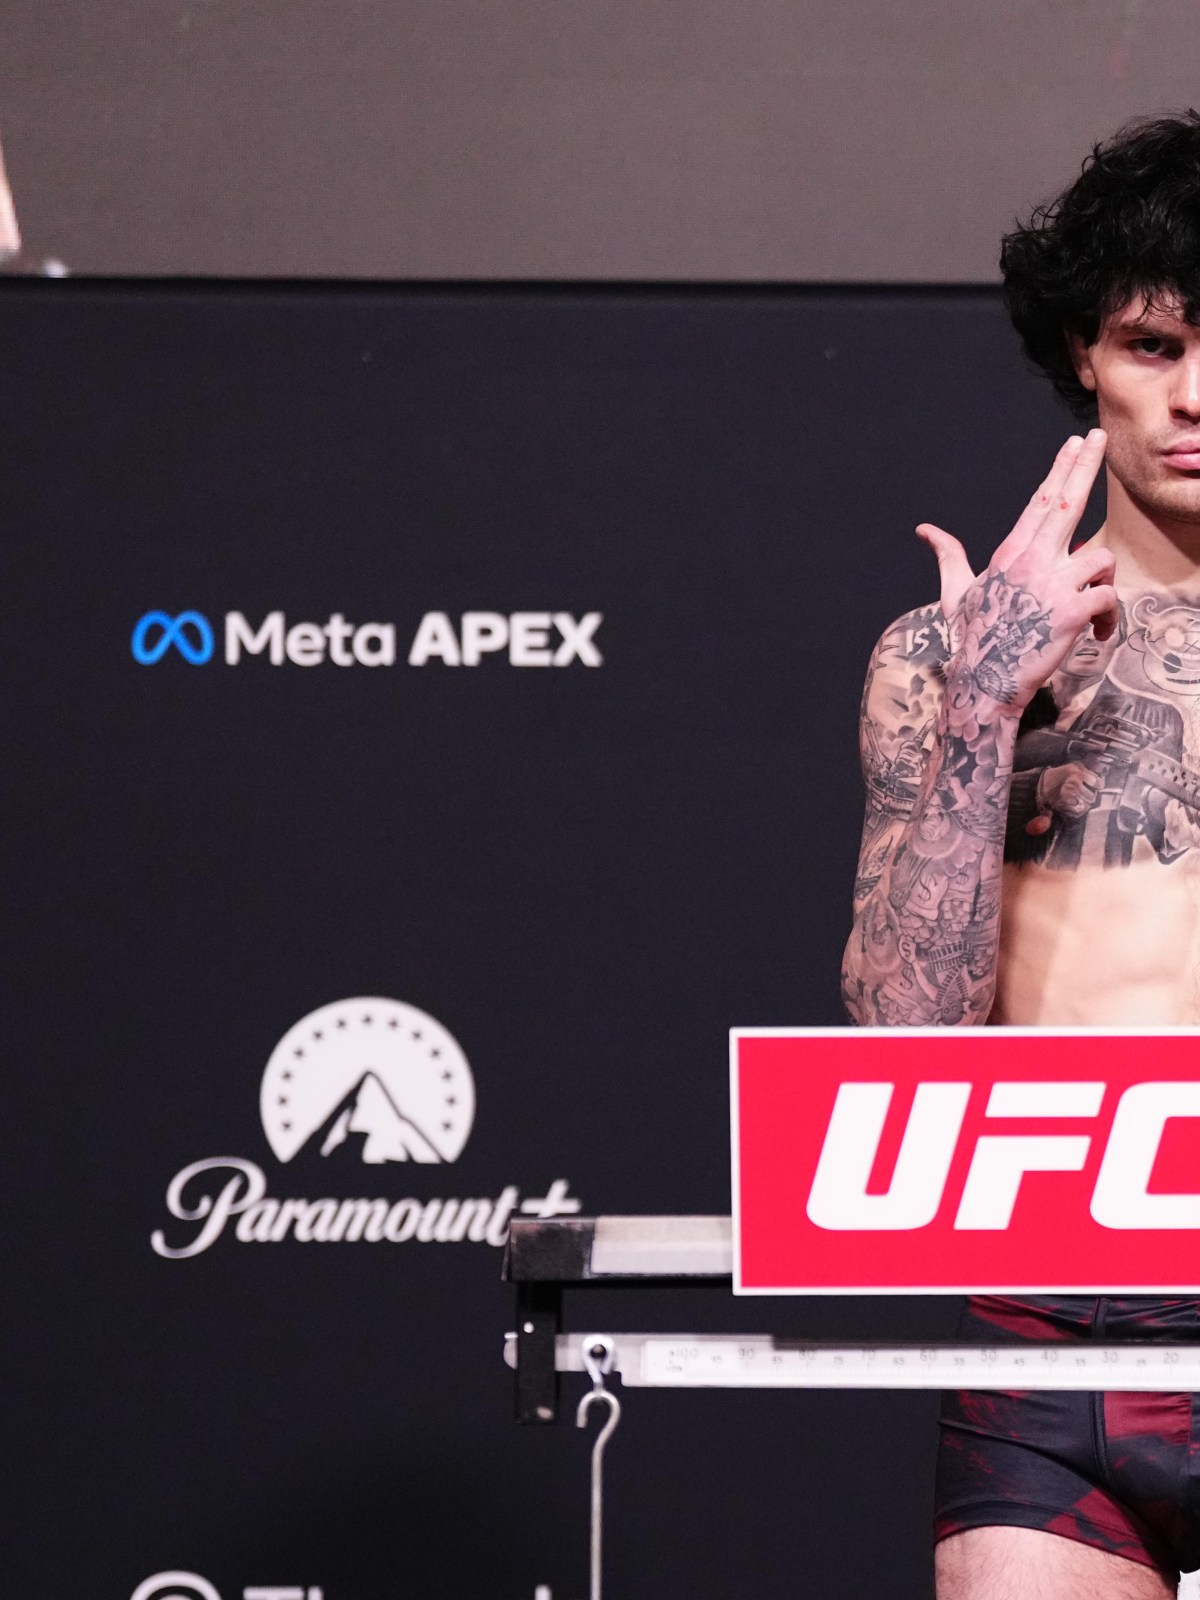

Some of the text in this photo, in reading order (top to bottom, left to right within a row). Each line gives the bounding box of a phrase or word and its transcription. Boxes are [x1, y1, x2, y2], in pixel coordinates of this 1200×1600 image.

[225, 611, 602, 667] Meta APEX
[738, 1348, 754, 1360] 90
[920, 1350, 937, 1361] 60
[981, 1350, 998, 1362] 50
[1041, 1351, 1058, 1363] 40
[1102, 1351, 1119, 1364] 30
[1163, 1352, 1179, 1364] 20
